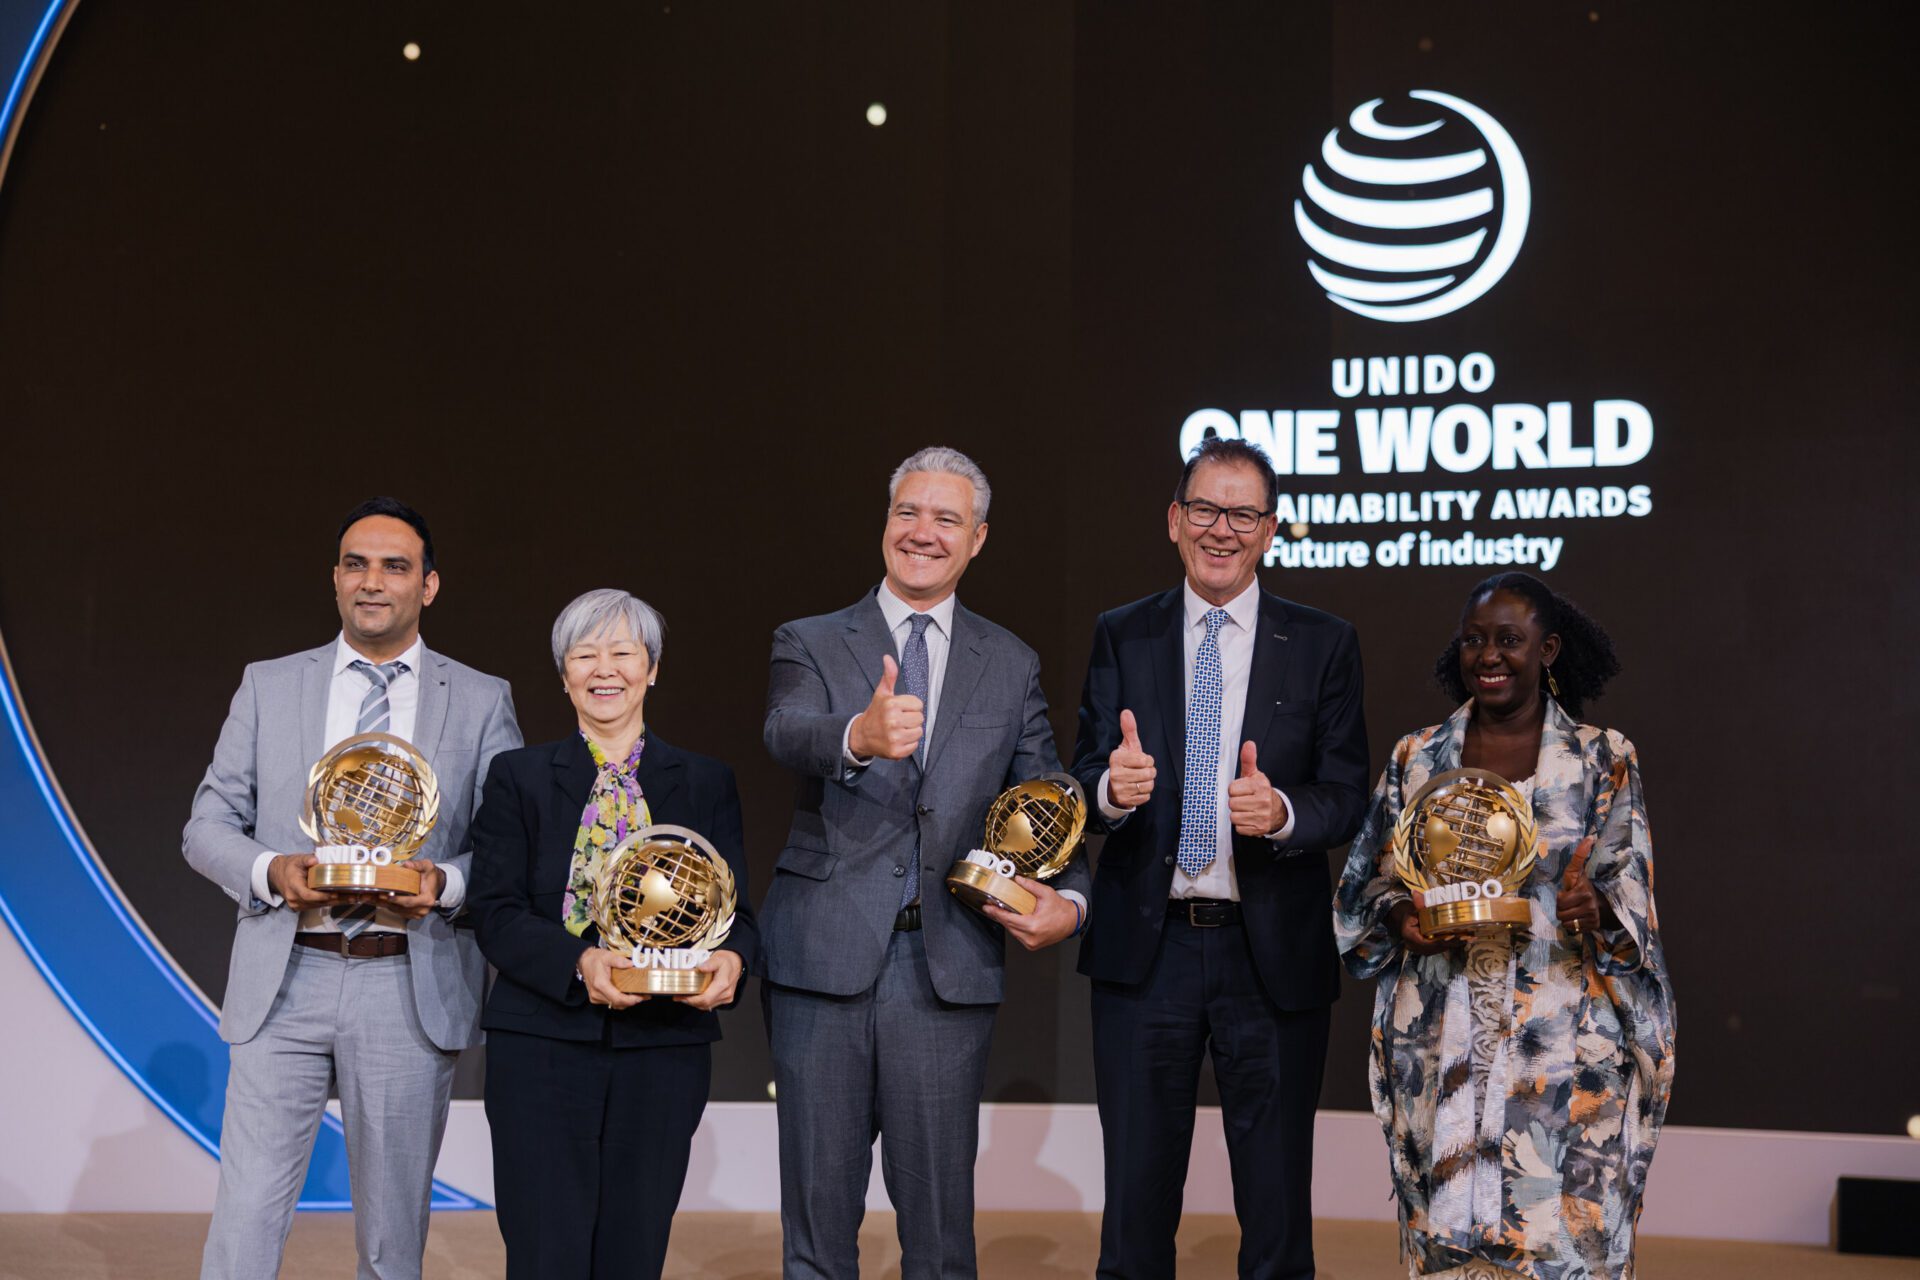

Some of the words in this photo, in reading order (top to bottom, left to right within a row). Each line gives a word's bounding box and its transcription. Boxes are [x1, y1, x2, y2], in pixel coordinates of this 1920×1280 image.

[1332, 352, 1495, 398] UNIDO
[1179, 408, 1341, 475] ONE
[1355, 400, 1654, 474] WORLD
[1277, 489, 1481, 524] AINABILITY
[1490, 485, 1652, 520] AWARDS
[1263, 535, 1370, 568] Future
[1375, 532, 1416, 567] of
[1419, 530, 1564, 571] industry
